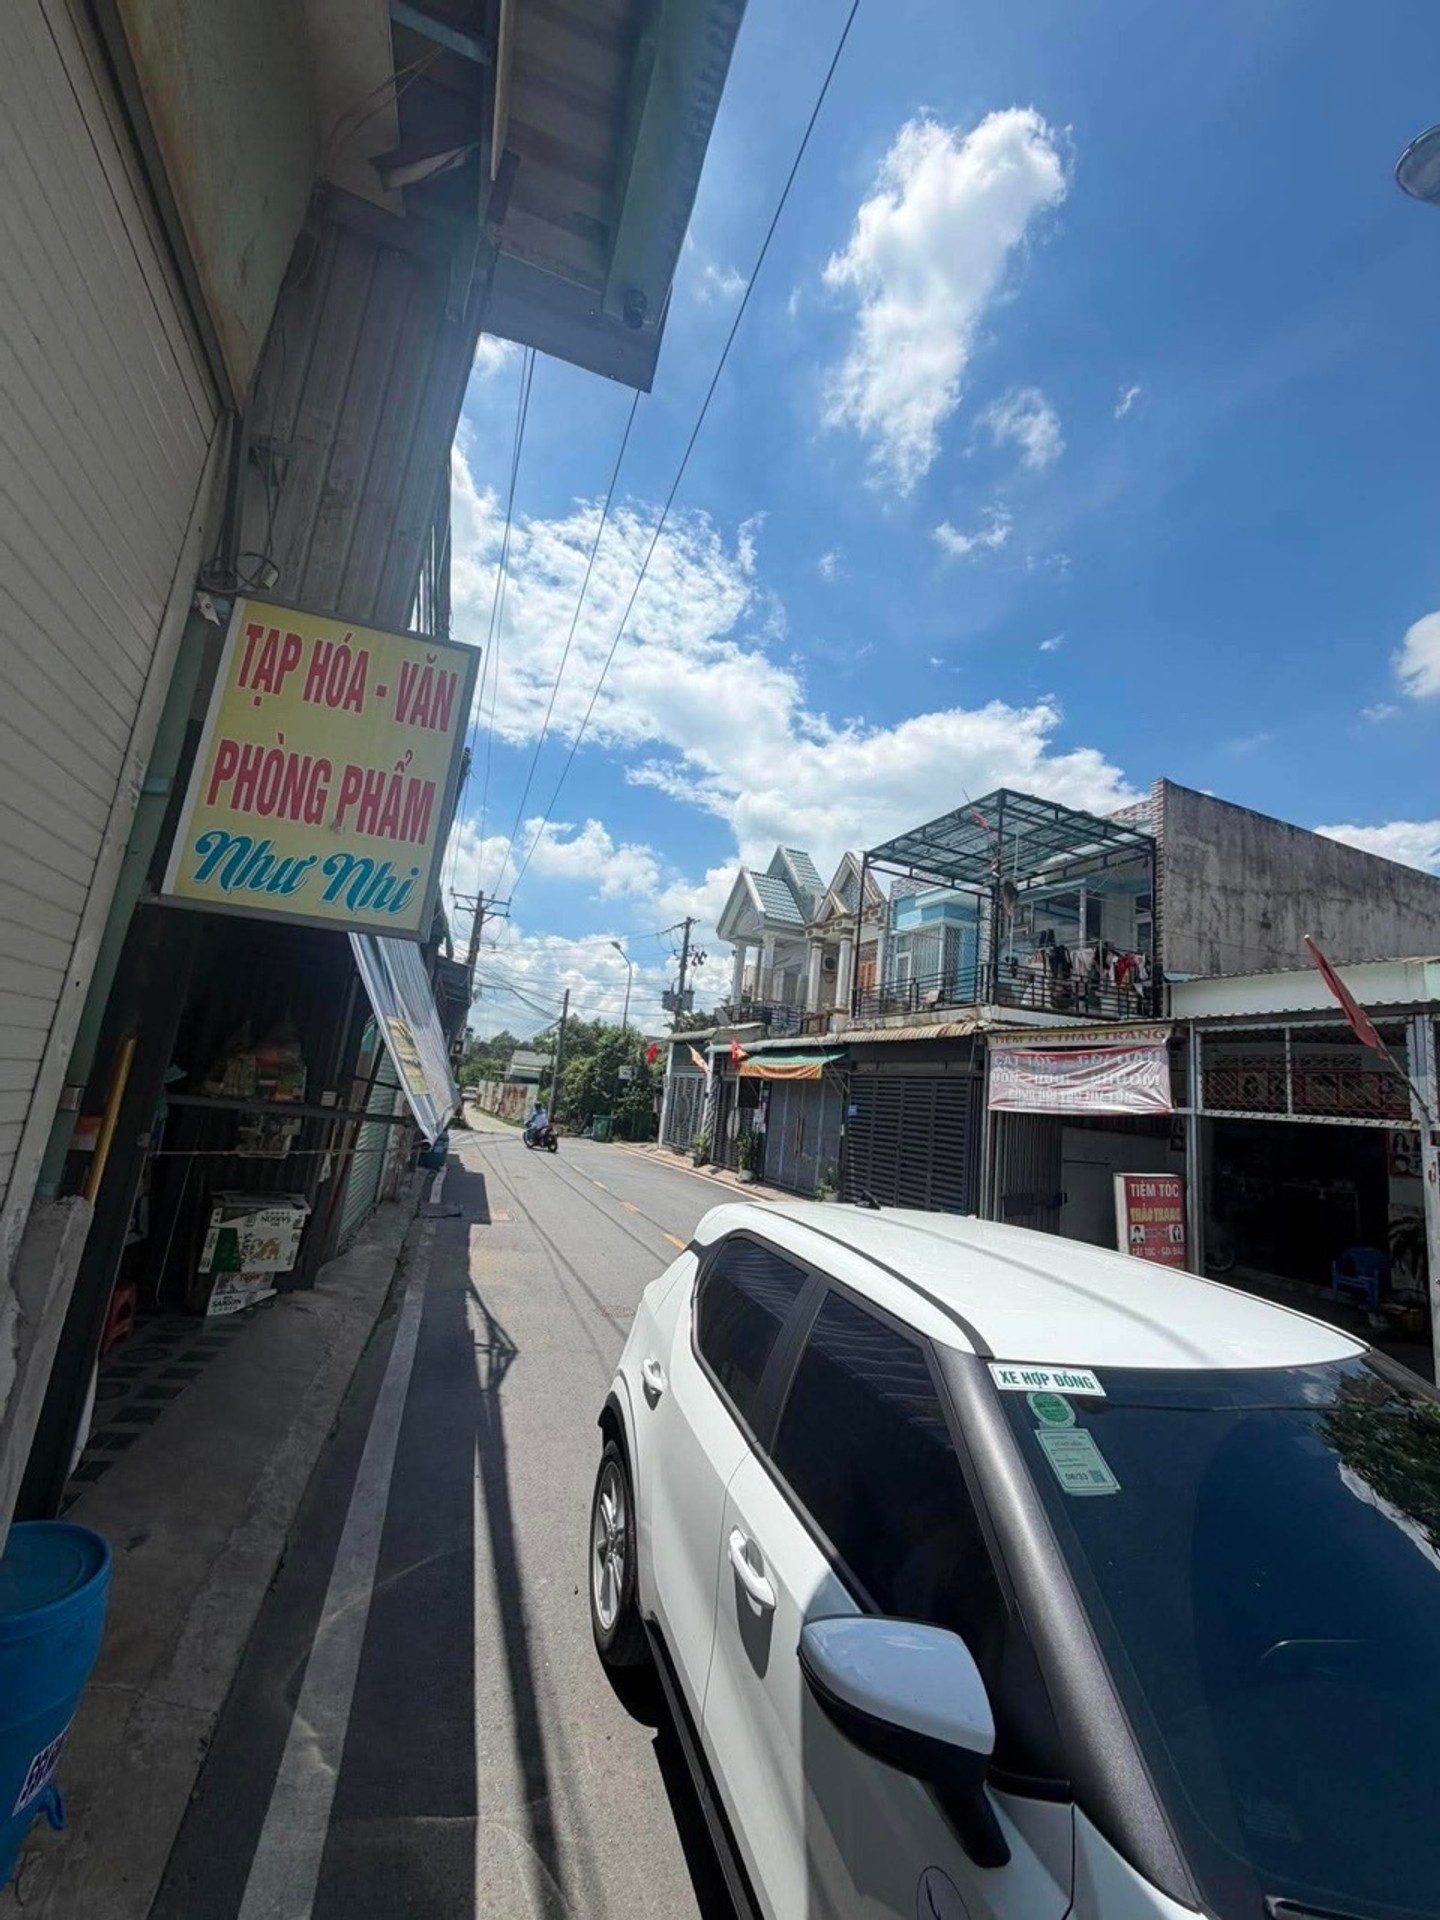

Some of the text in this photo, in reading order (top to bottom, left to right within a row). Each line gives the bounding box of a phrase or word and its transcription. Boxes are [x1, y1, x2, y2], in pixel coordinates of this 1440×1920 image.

[238, 624, 303, 706] TẠP
[303, 633, 370, 714] HÓA
[395, 653, 459, 732] VĂN
[206, 732, 437, 845] PHÒNG PHẨM
[193, 830, 421, 915] Như Nhi
[1159, 1180, 1180, 1197] TÓC
[999, 1370, 1095, 1389] XE HỢP ĐỒNG
